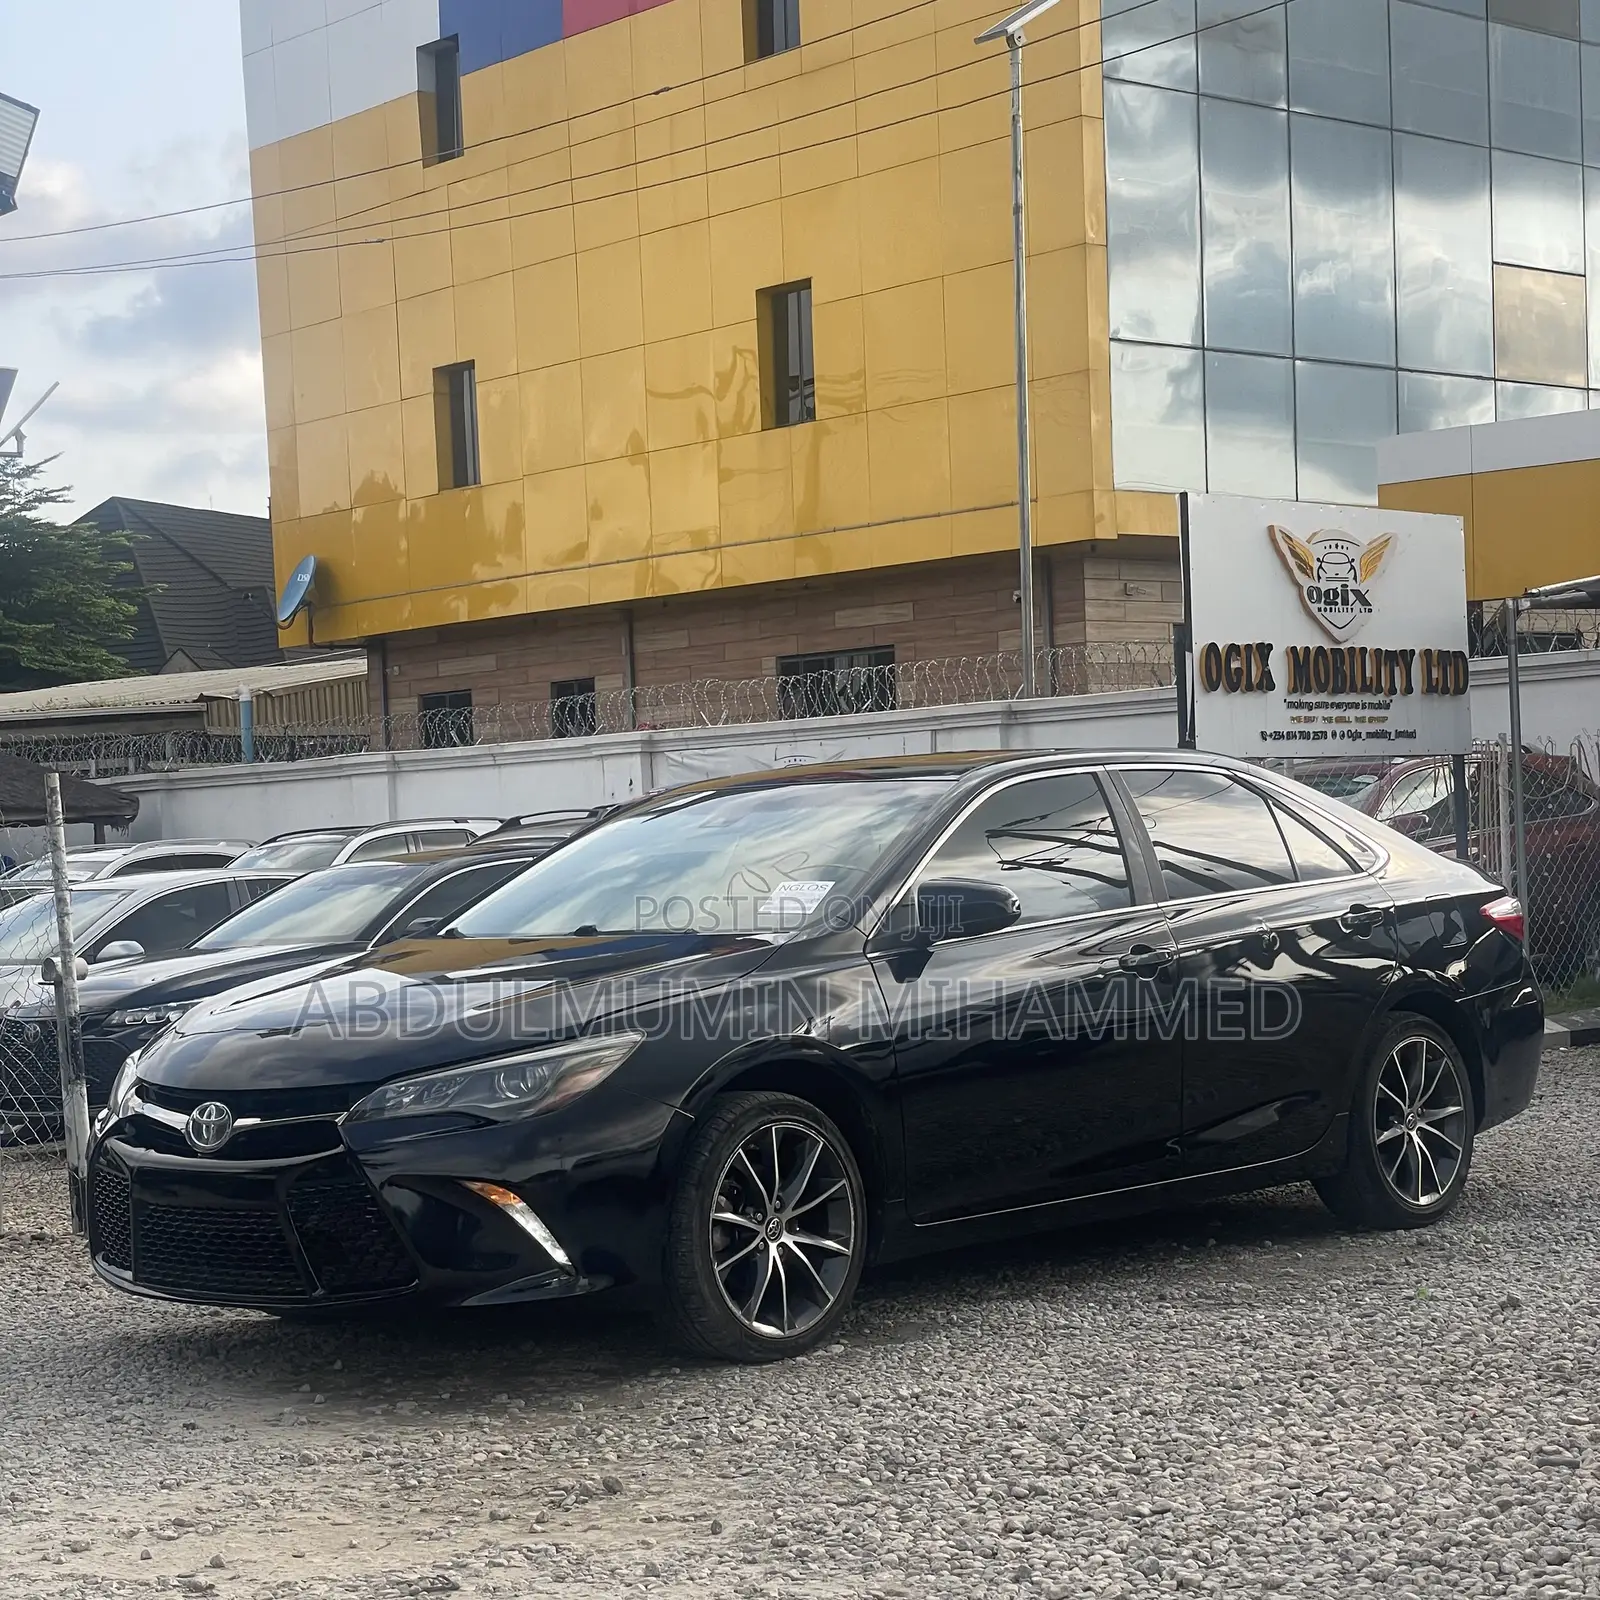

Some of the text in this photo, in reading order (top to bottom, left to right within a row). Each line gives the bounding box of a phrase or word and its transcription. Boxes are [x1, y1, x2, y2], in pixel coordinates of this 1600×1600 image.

[1201, 642, 1470, 696] OGIX MOBILITY LTD
[1314, 701, 1330, 709] sure
[1330, 701, 1360, 712] everyone
[1361, 699, 1367, 710] is
